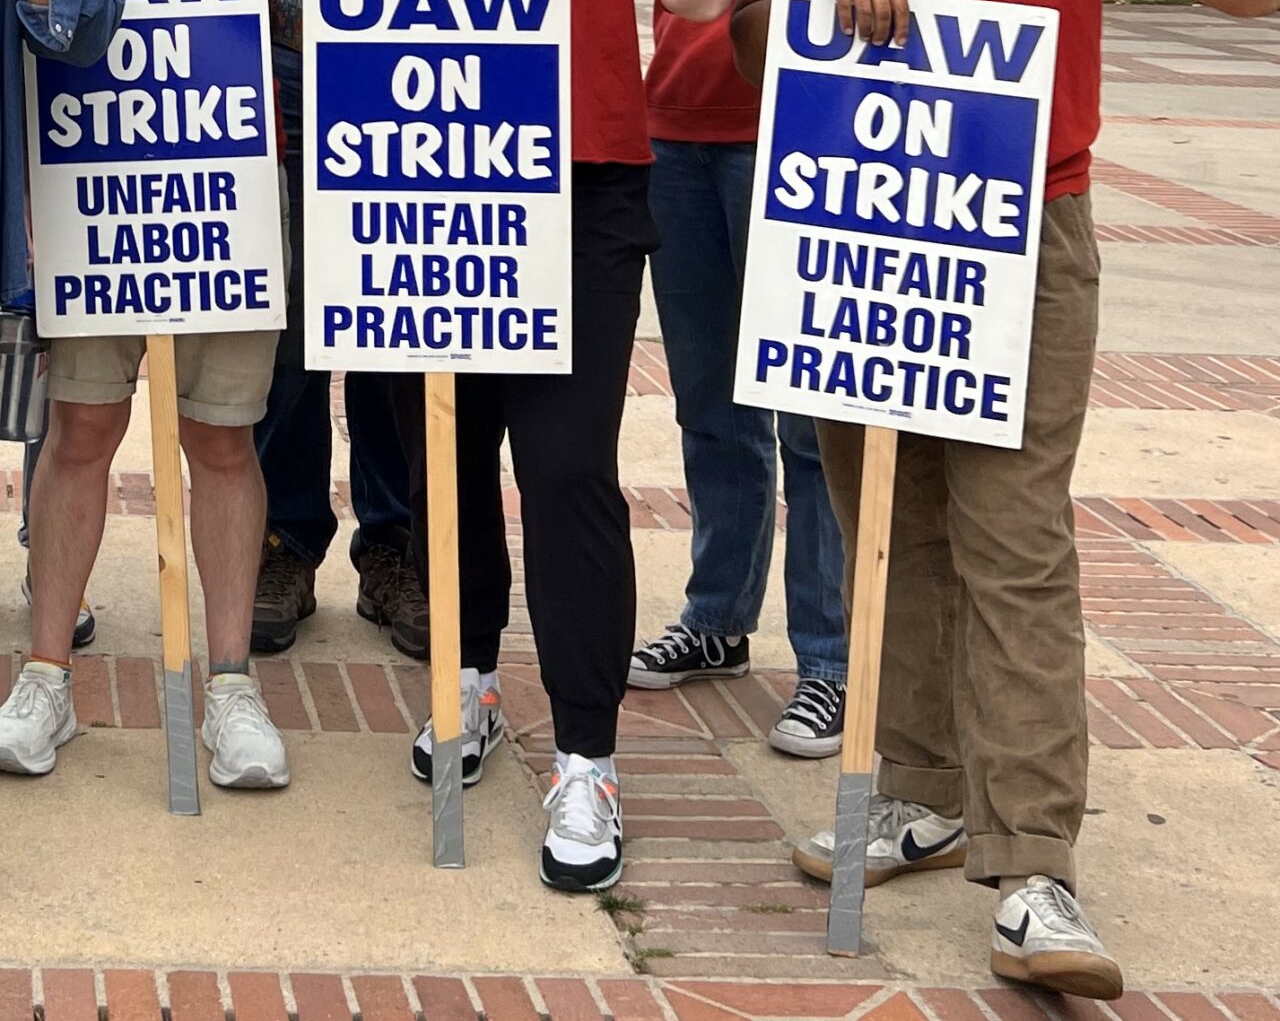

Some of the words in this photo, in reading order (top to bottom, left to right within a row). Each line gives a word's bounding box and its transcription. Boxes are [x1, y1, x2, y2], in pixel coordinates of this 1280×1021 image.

[107, 24, 191, 82] ON
[391, 54, 481, 112] ON
[47, 84, 259, 148] STRIKE
[854, 92, 953, 158] ON
[324, 121, 553, 179] STRIKE
[76, 171, 237, 216] UNFAIR
[774, 151, 1024, 238] STRIKE
[87, 221, 230, 265] LABOR
[352, 202, 527, 246] UNFAIR
[54, 268, 270, 316] PRACTICE
[361, 254, 519, 298] LABOR
[797, 236, 987, 307] UNFAIR
[323, 305, 558, 351] PRACTICE
[800, 291, 972, 360] LABOR
[755, 338, 1011, 422] PRACTICE
